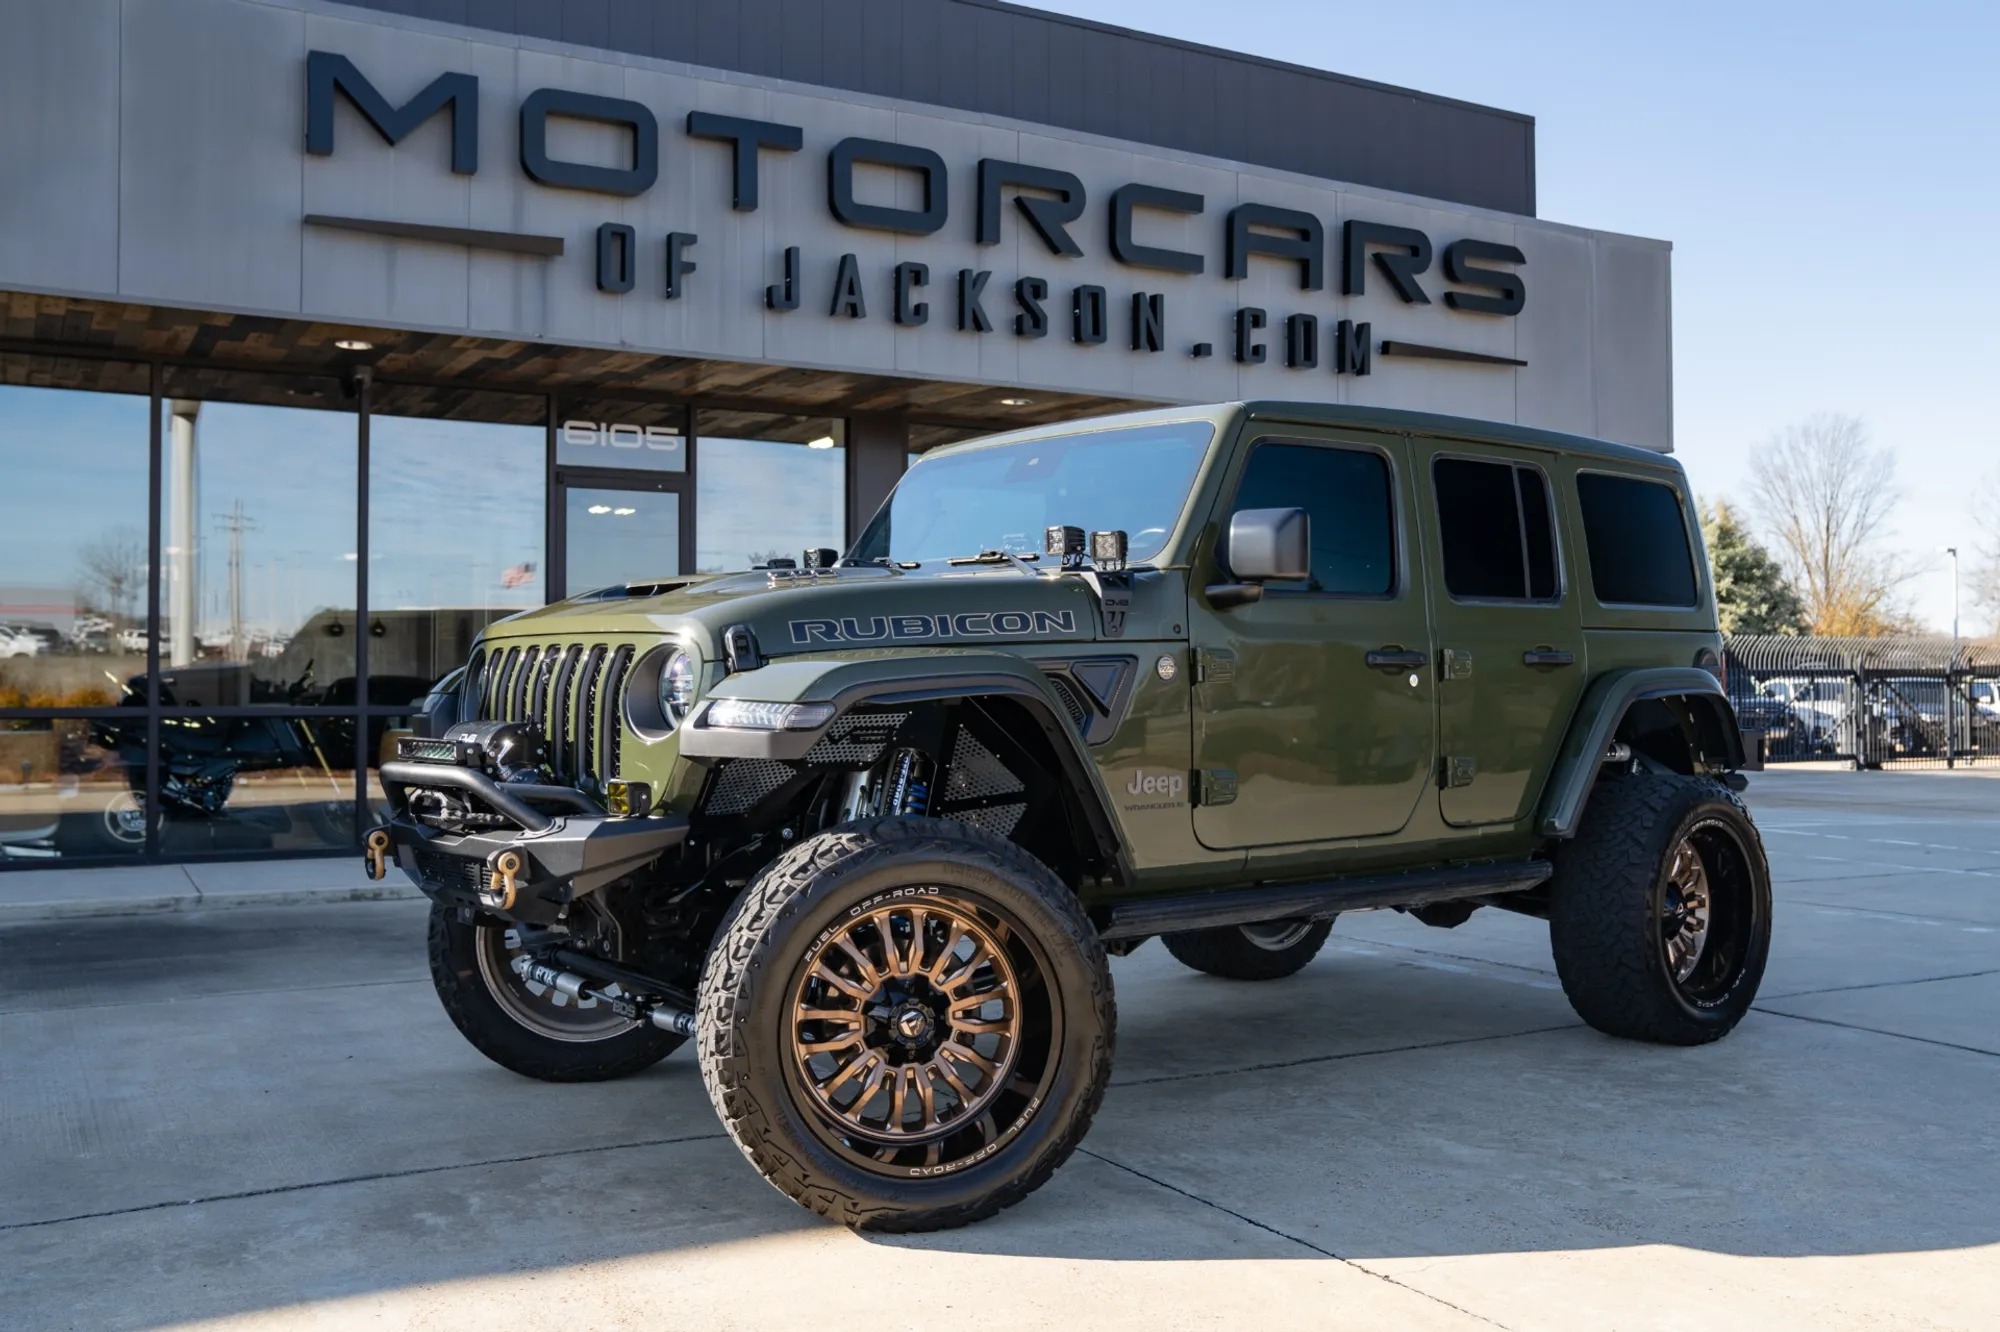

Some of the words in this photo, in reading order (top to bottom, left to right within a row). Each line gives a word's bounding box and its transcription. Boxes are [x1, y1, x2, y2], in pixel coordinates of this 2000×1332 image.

[305, 48, 1528, 318] MOTORCARS
[596, 221, 698, 300] OF
[563, 420, 679, 451] 6105
[788, 610, 1077, 644] RUBICON
[1126, 769, 1184, 798] Jeep
[804, 924, 840, 962] FUEL
[850, 886, 939, 917] OFF-ROAD
[535, 966, 557, 987] FOX
[612, 1000, 636, 1018] BDS
[1007, 1097, 1040, 1135] FUEL
[909, 1143, 998, 1176] OFF-ROAD
